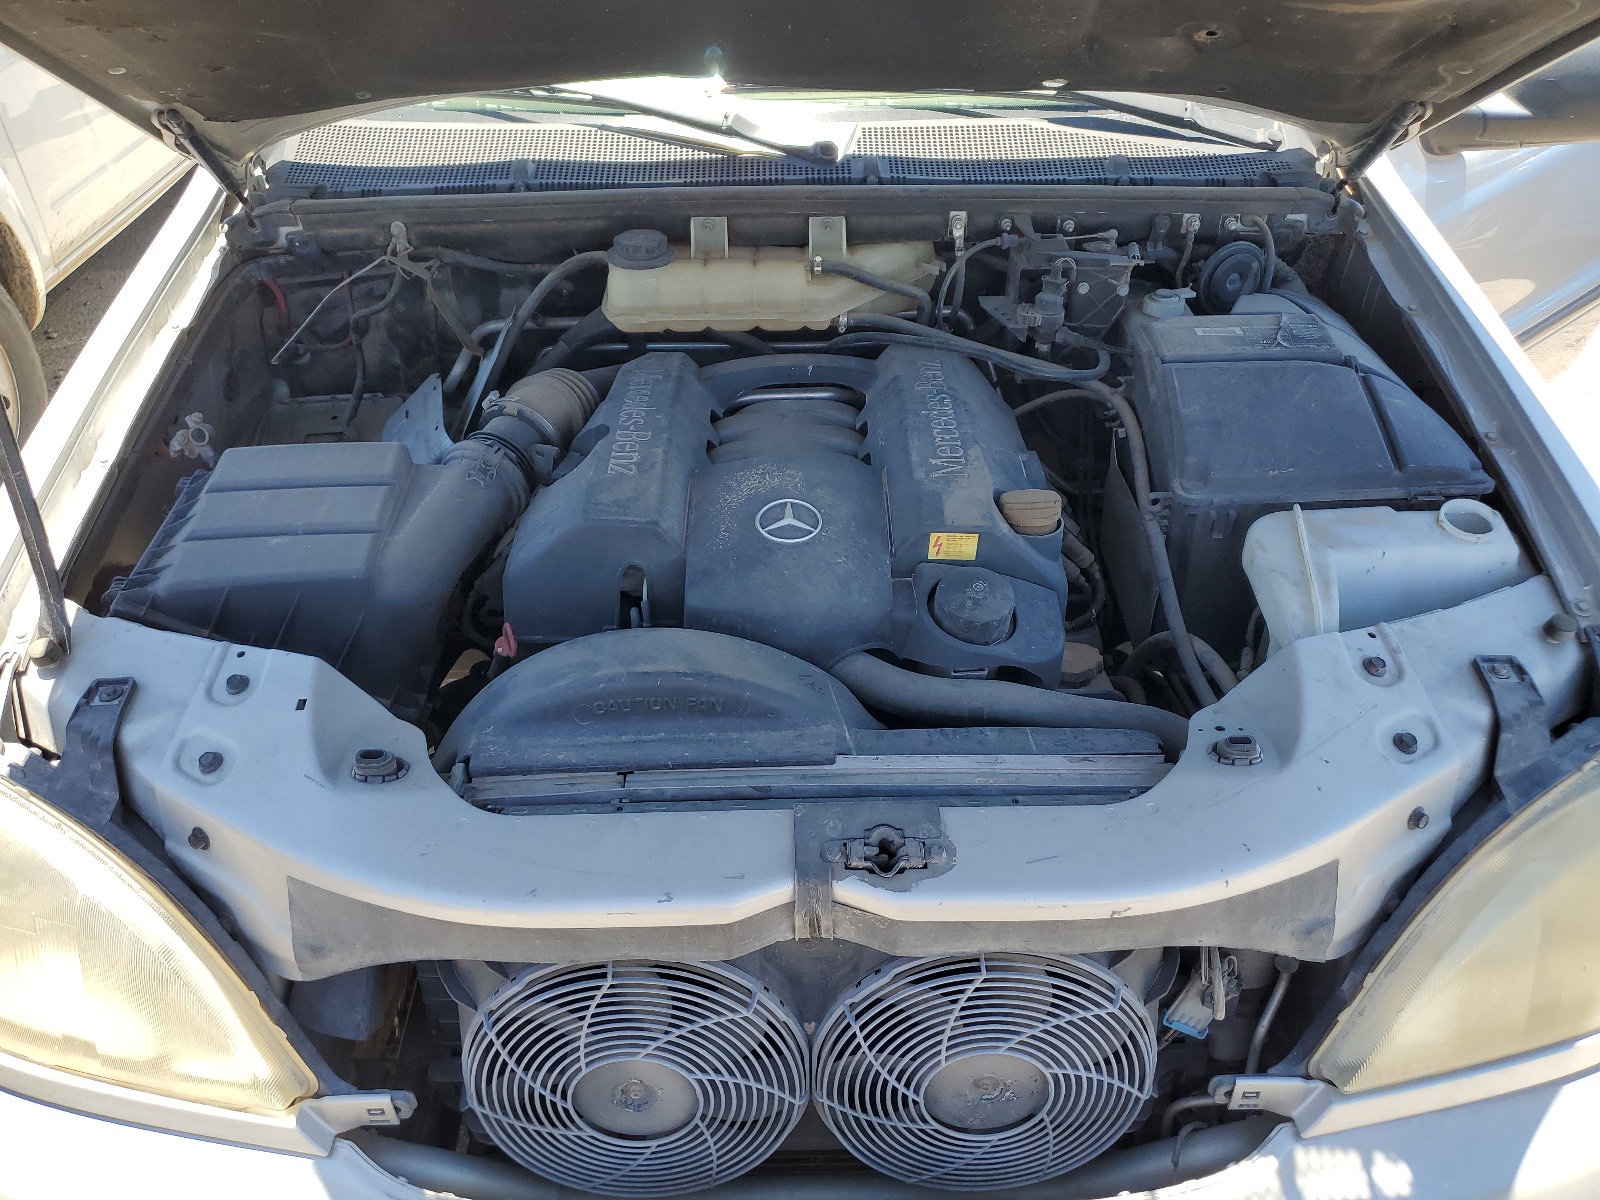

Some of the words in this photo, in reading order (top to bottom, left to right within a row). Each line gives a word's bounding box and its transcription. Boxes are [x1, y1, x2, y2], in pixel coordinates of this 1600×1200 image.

[607, 368, 666, 476] Mercedes-Benz
[914, 359, 968, 479] Mercedes-Benz
[593, 697, 678, 715] CAUTION
[686, 697, 724, 713] FAN
